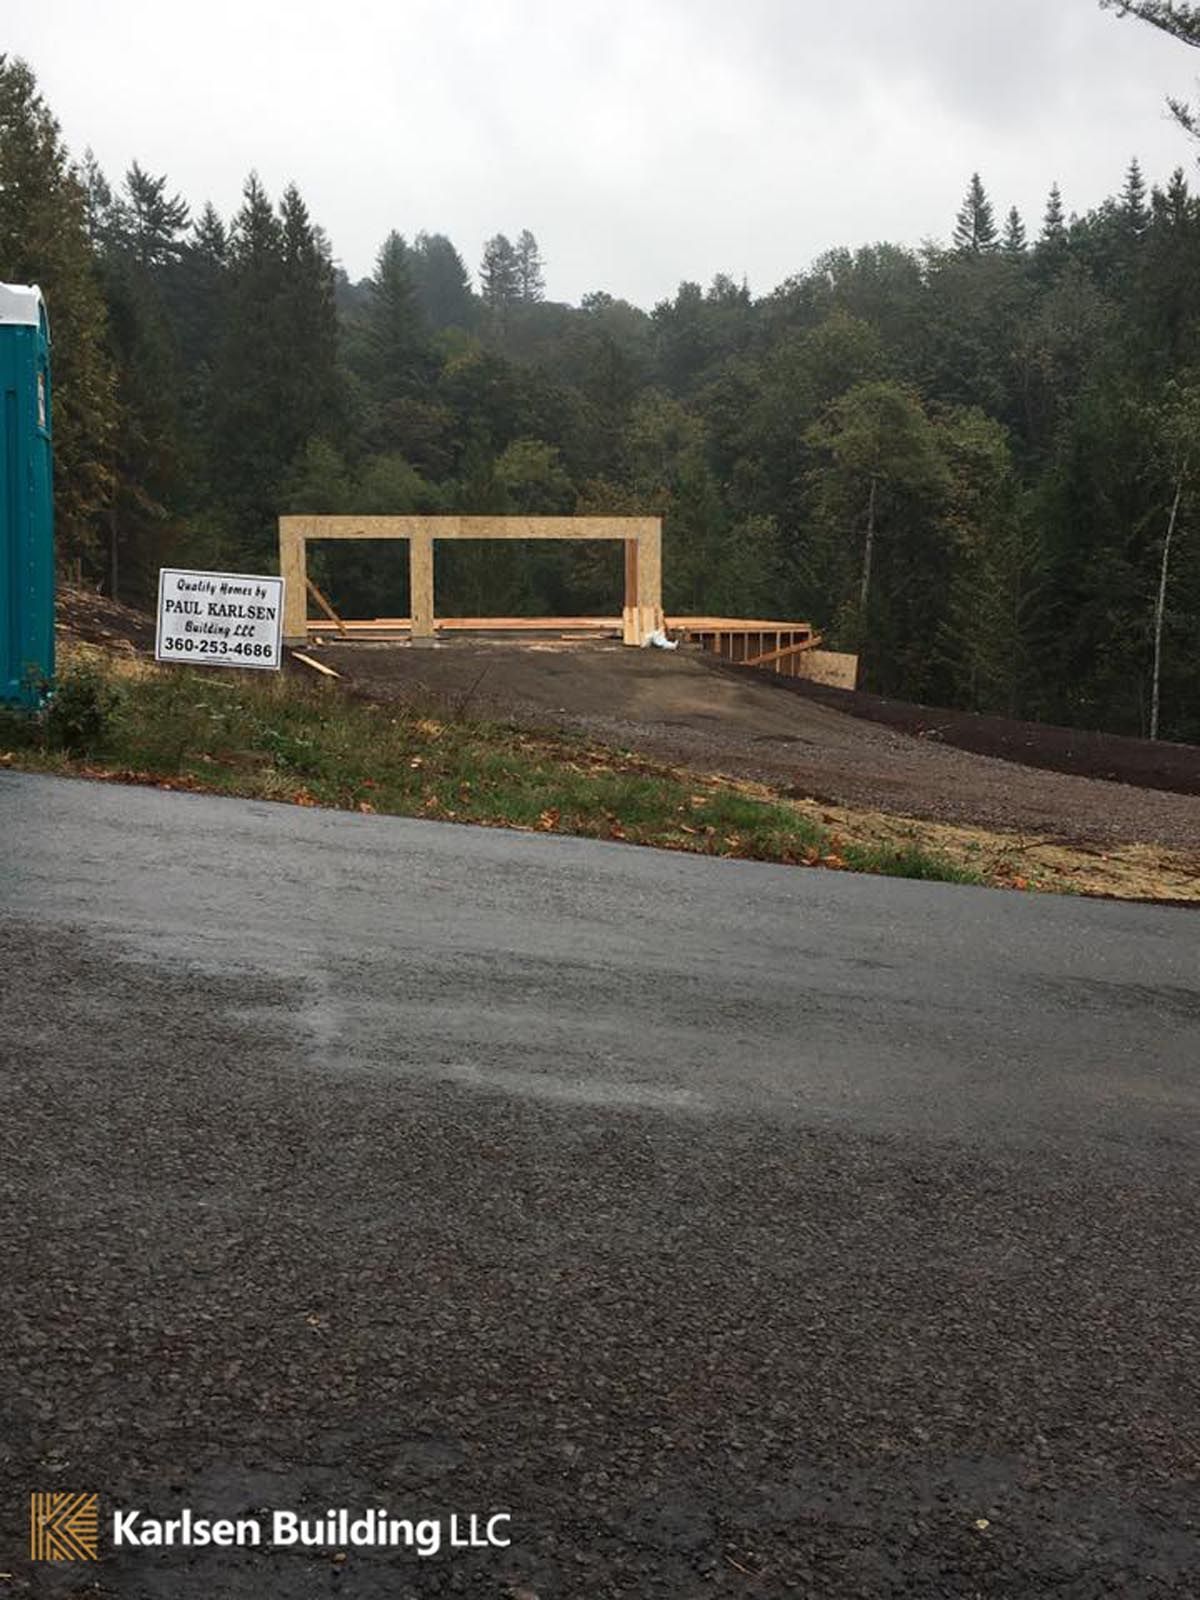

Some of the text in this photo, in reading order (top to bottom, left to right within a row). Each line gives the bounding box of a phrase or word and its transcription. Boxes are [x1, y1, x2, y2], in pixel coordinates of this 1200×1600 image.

[177, 578, 267, 599] Quality Homes by
[165, 600, 276, 620] PAUL KARLSEN
[185, 620, 256, 638] Building LLC
[165, 637, 272, 657] 360-253-4686
